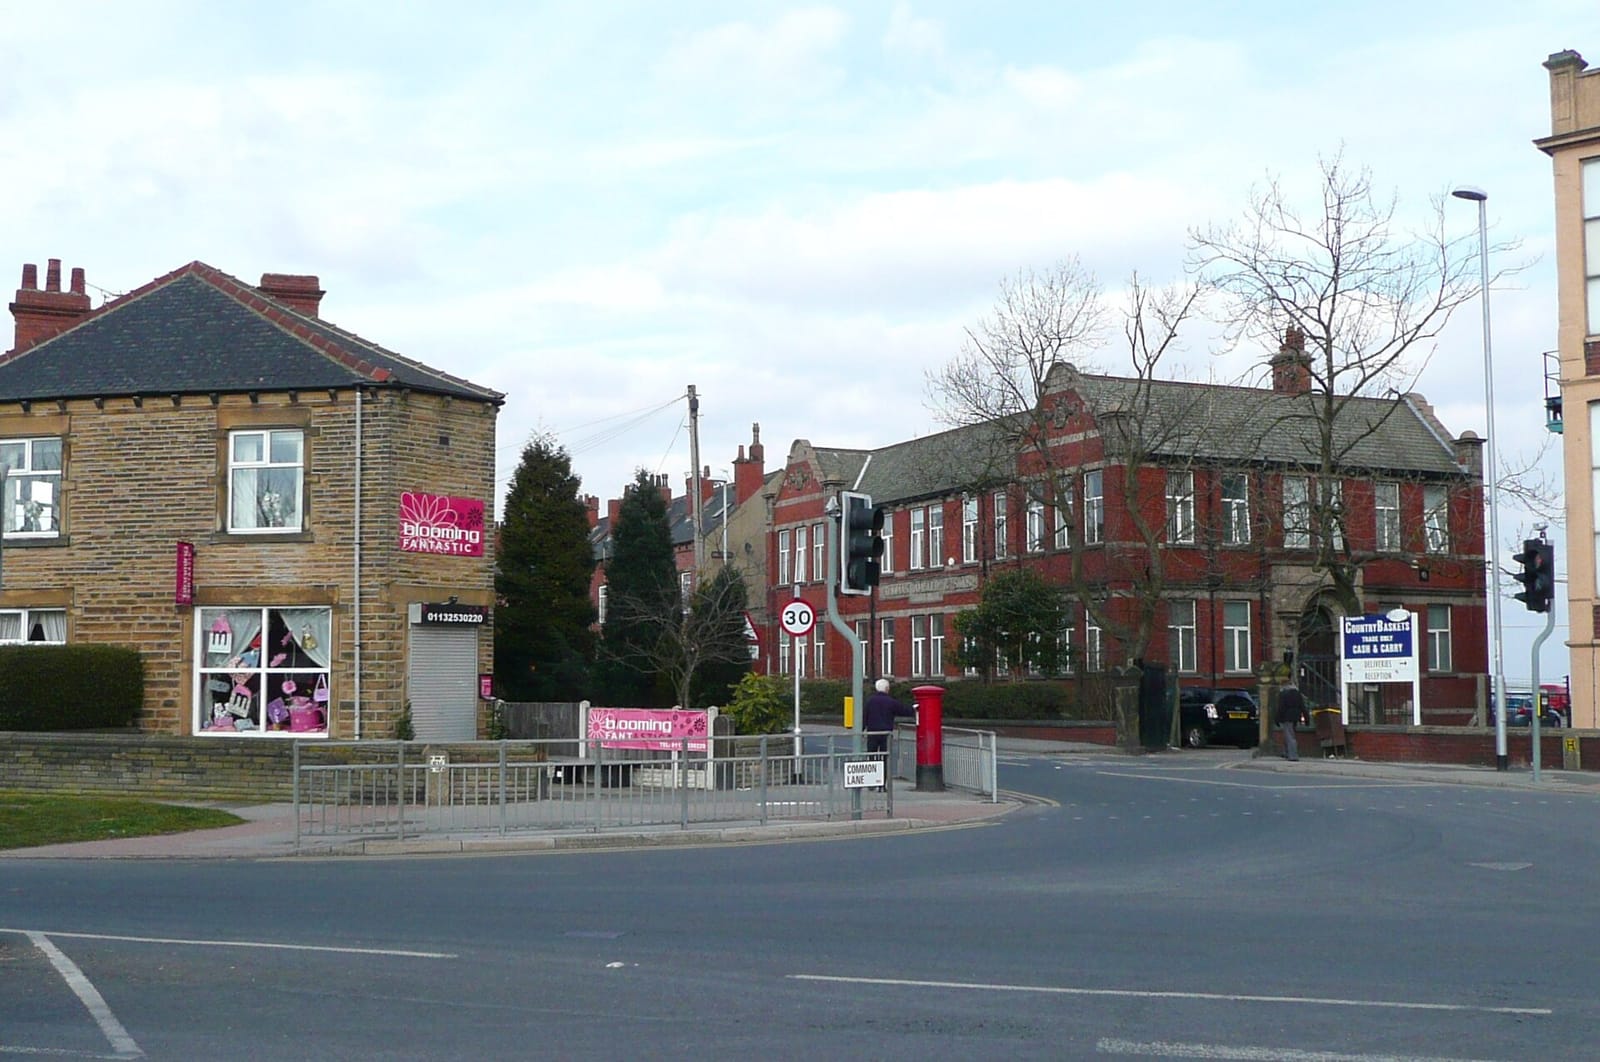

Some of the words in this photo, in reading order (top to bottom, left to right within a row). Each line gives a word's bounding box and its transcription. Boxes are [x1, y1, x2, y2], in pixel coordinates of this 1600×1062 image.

[403, 522, 480, 544] blooming
[403, 539, 472, 554] FANTASTIC
[427, 612, 483, 623] 01132530220
[785, 611, 811, 626] 30
[1352, 644, 1371, 654] CASH
[1372, 644, 1378, 653] &
[1380, 643, 1403, 653] CARRY
[1364, 660, 1392, 668] DELIVERIES
[1365, 672, 1392, 680] RECEPTION
[605, 717, 672, 733] blooming
[847, 763, 877, 774] COMMON
[847, 775, 865, 785] LANE
